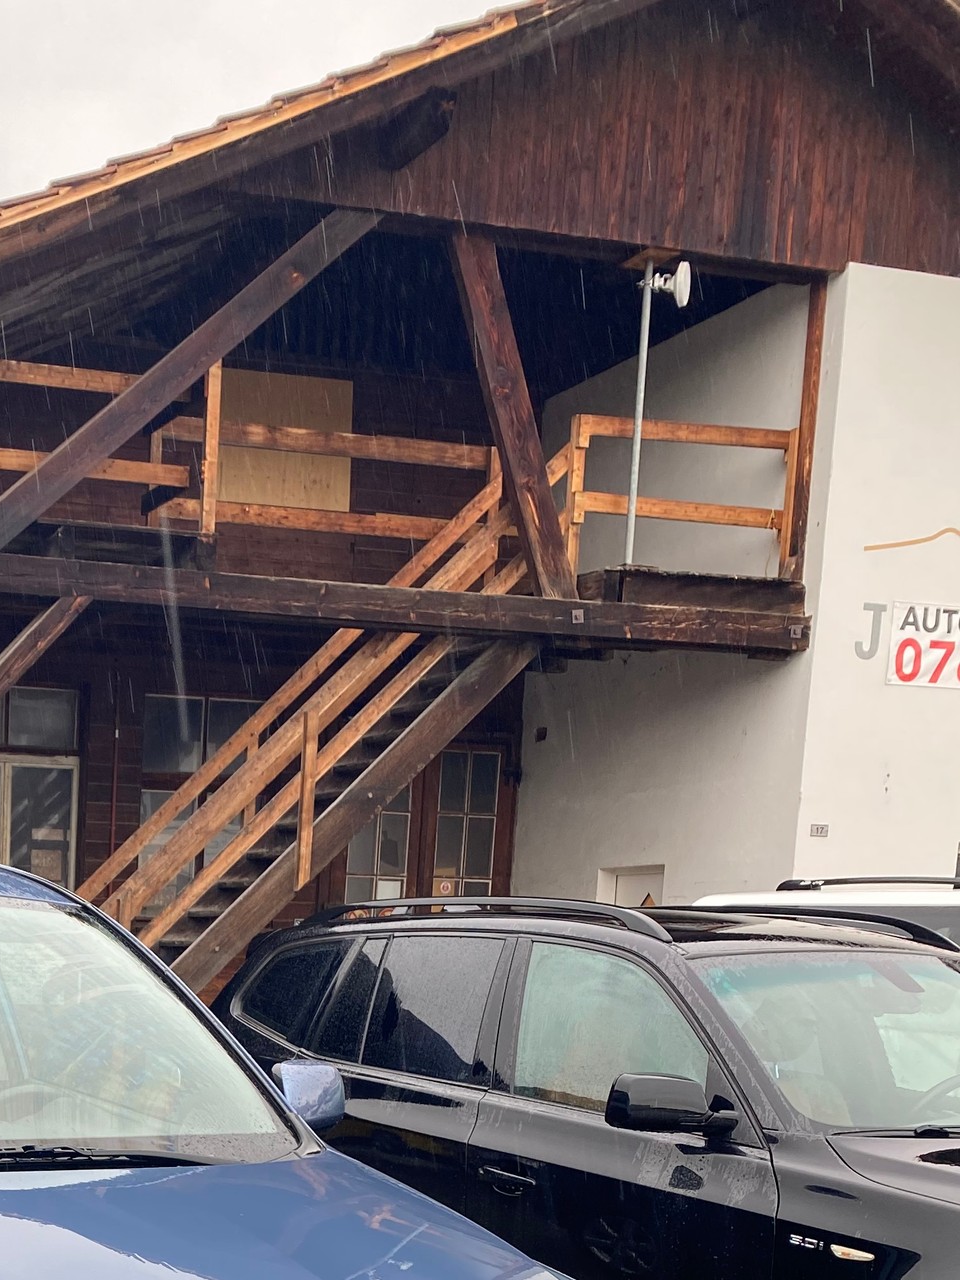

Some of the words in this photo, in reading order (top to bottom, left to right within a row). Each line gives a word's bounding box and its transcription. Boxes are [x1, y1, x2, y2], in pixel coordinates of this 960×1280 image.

[855, 603, 887, 660] J
[900, 606, 960, 634] AUT
[895, 638, 960, 683] 07
[815, 826, 825, 835] 17
